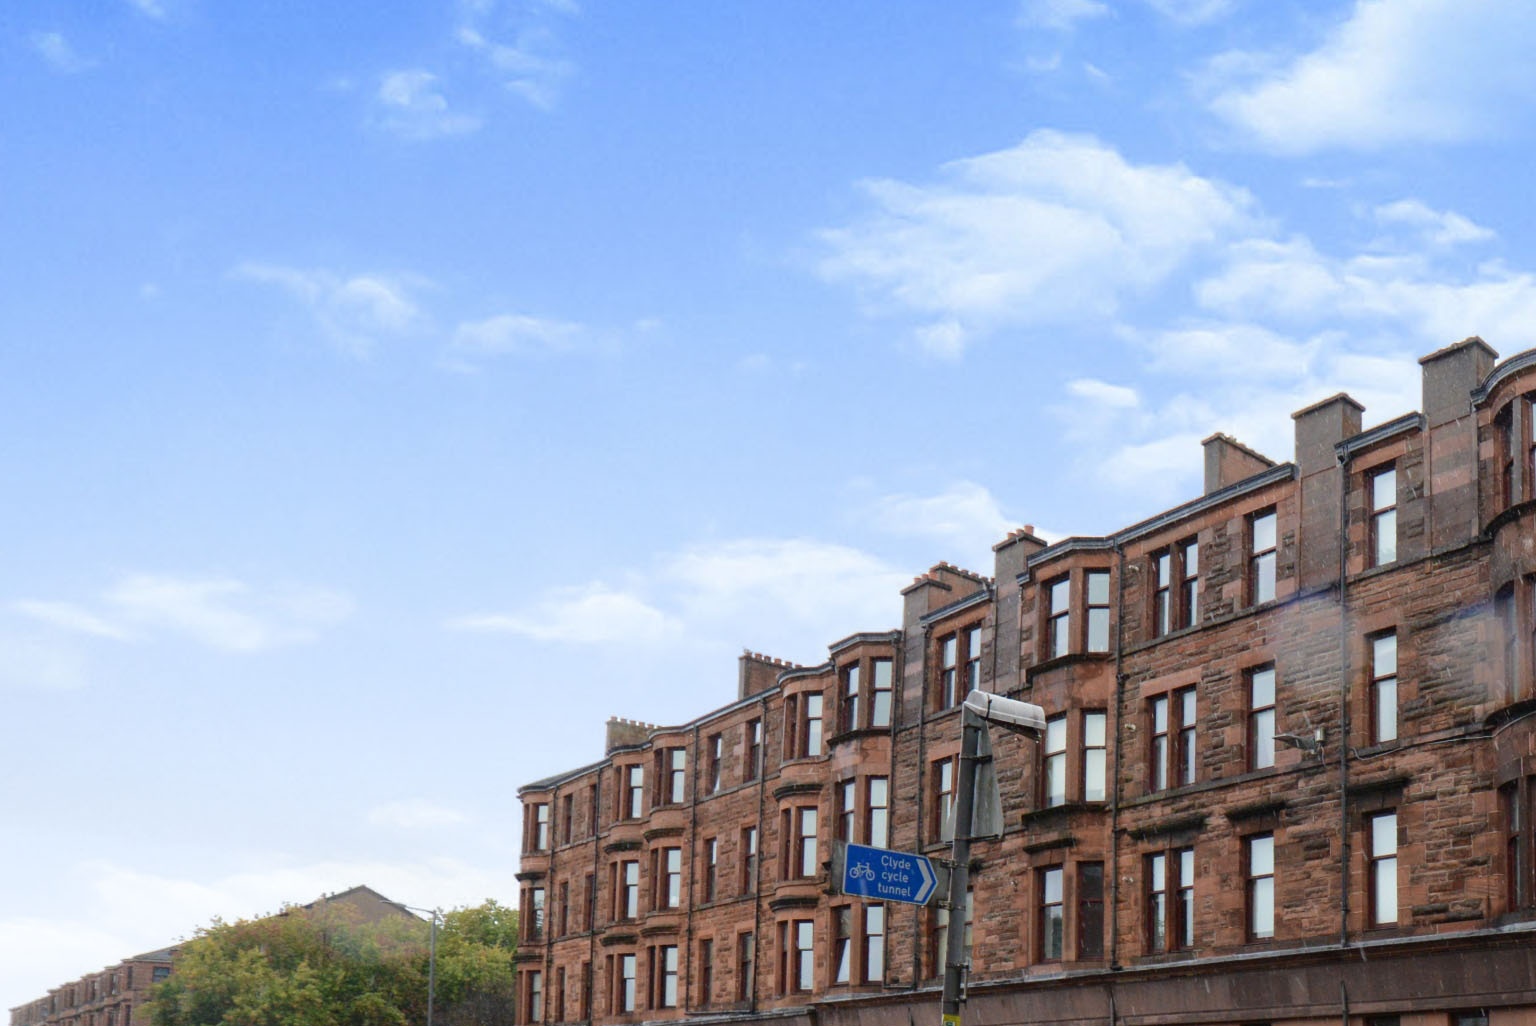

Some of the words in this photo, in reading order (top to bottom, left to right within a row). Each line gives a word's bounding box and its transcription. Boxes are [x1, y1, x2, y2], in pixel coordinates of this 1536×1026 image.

[881, 855, 911, 870] Clyde
[881, 871, 909, 883] cycle
[878, 882, 911, 897] tunnel
